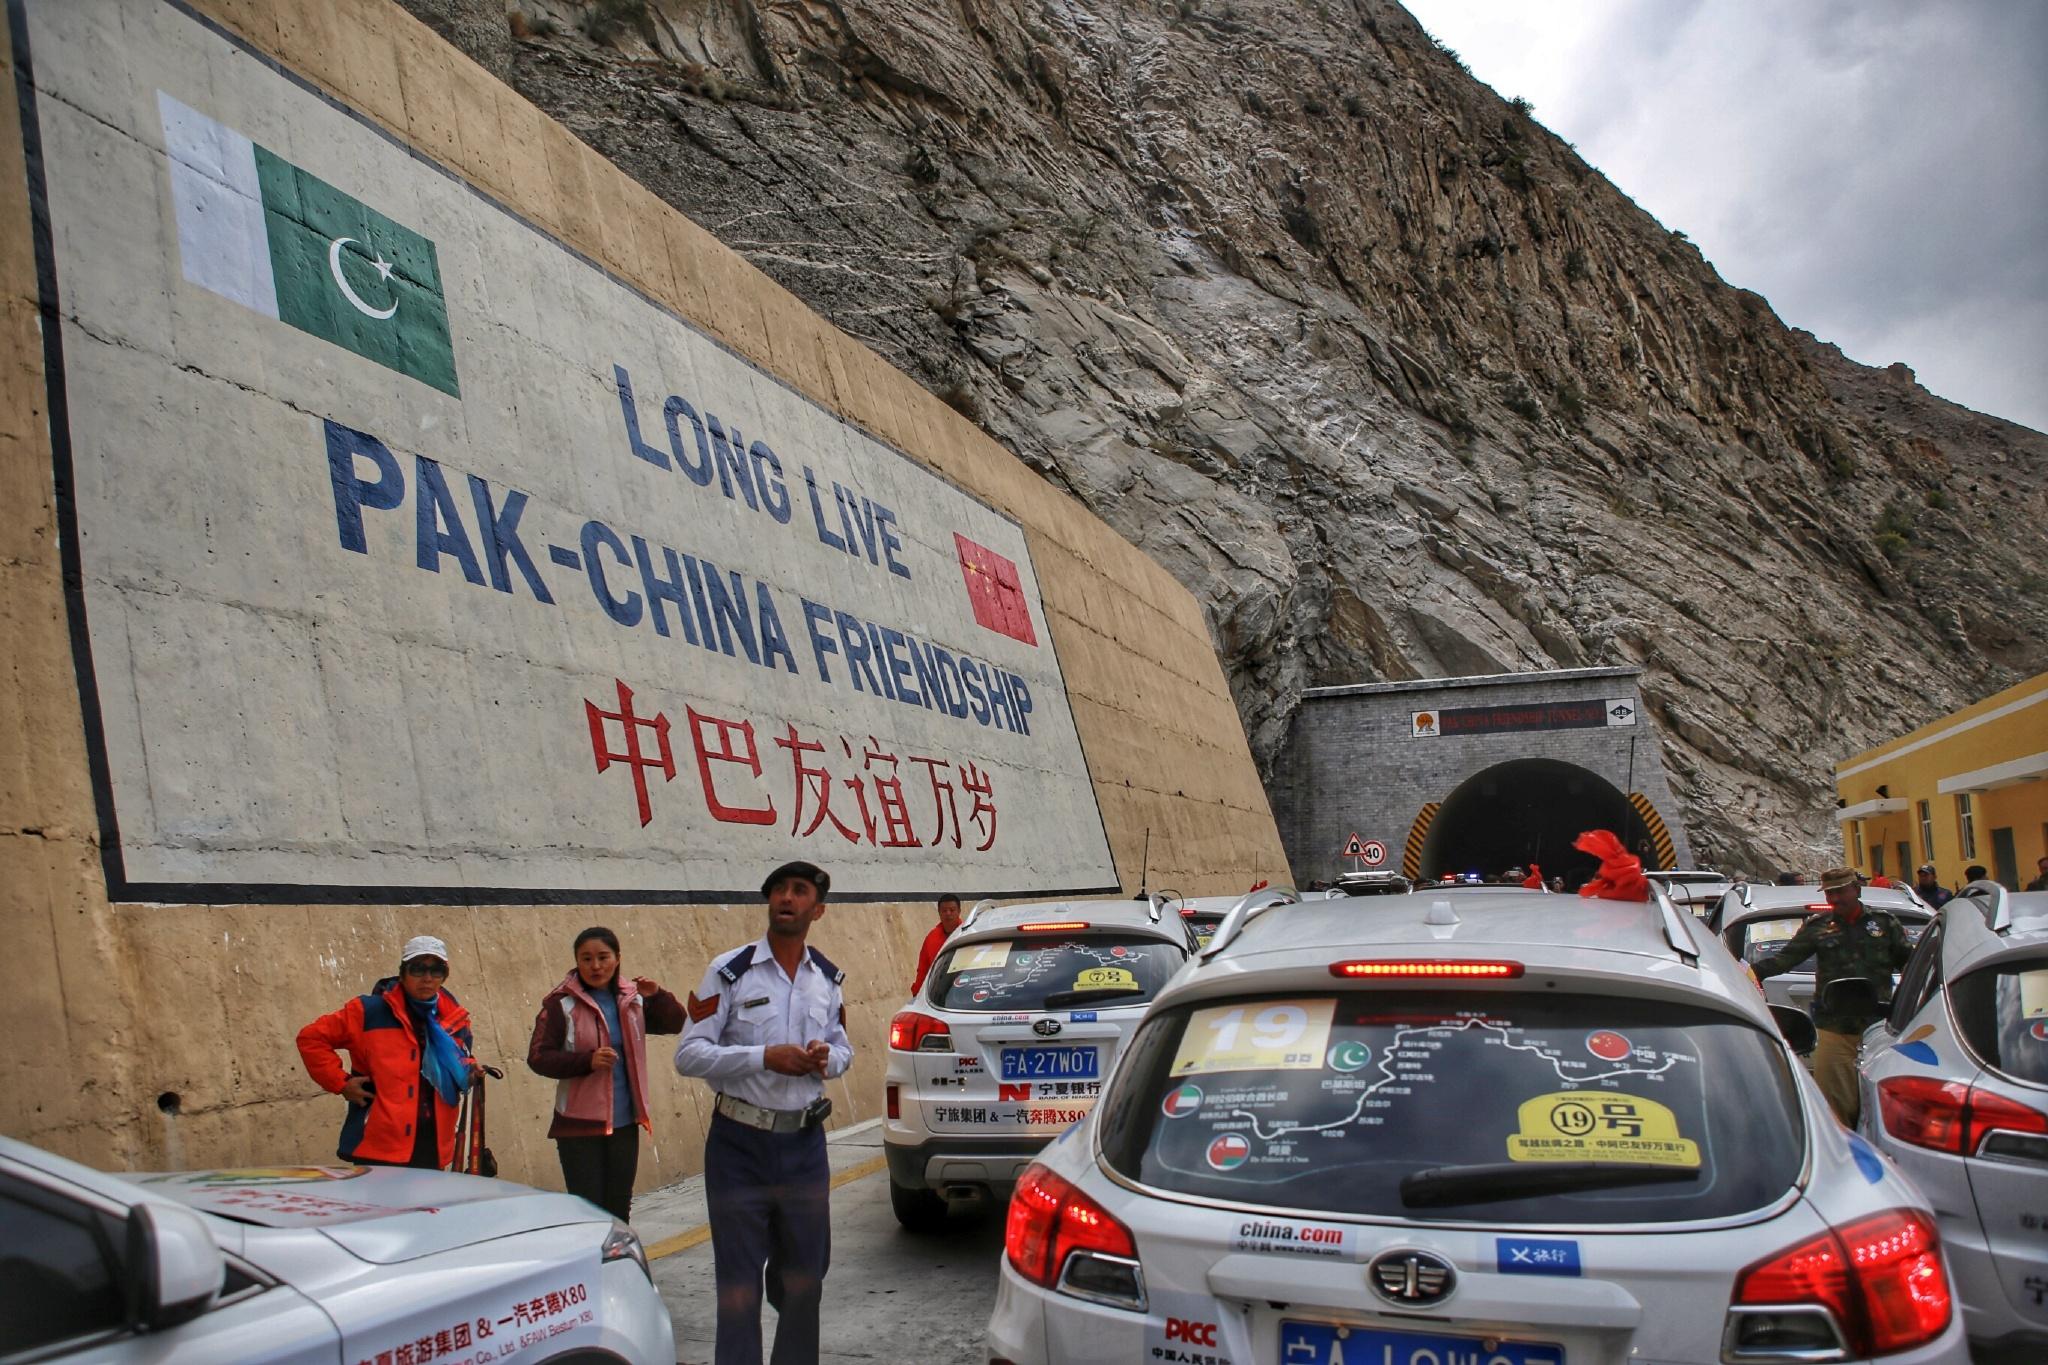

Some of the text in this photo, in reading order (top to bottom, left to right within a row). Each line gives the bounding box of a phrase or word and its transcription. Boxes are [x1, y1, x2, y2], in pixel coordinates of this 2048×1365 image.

[614, 363, 910, 580] LONG LIVE
[323, 418, 1033, 737] PAK-CHINA FRIENDSHIP
[583, 677, 998, 853] 中巴友谊万岁
[1366, 847, 1379, 859] 40
[1207, 1005, 1308, 1051] 19
[1039, 1082, 1102, 1095] 宁夏银行
[935, 1107, 986, 1124] 宁旅集团
[989, 1111, 999, 1122] &
[1240, 1220, 1343, 1244] china.com
[476, 1317, 494, 1339] &
[497, 1283, 587, 1328] 一汽奔腾X80
[1165, 1316, 1217, 1348] PICC
